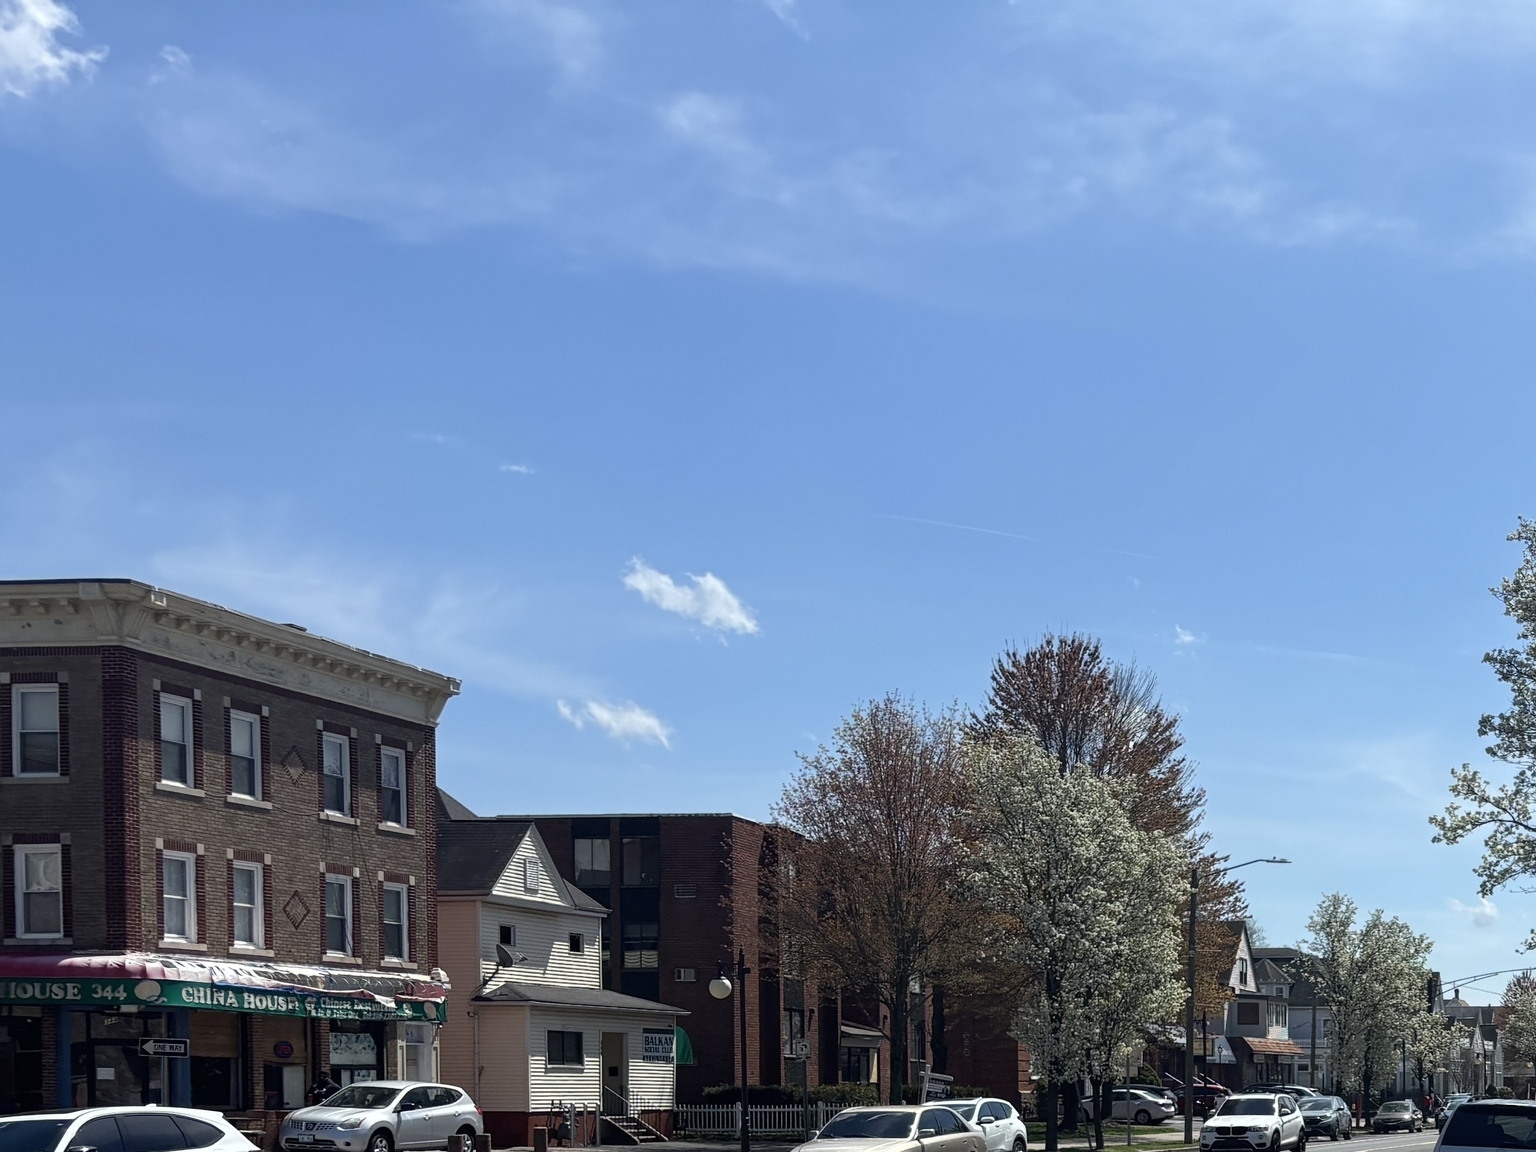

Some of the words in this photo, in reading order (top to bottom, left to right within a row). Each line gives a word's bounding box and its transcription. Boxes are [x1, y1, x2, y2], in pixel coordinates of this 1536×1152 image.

[91, 984, 127, 1000] 344
[182, 986, 239, 1008] CHINA
[154, 1043, 168, 1051] ONE
[645, 1036, 674, 1046] BALKAN
